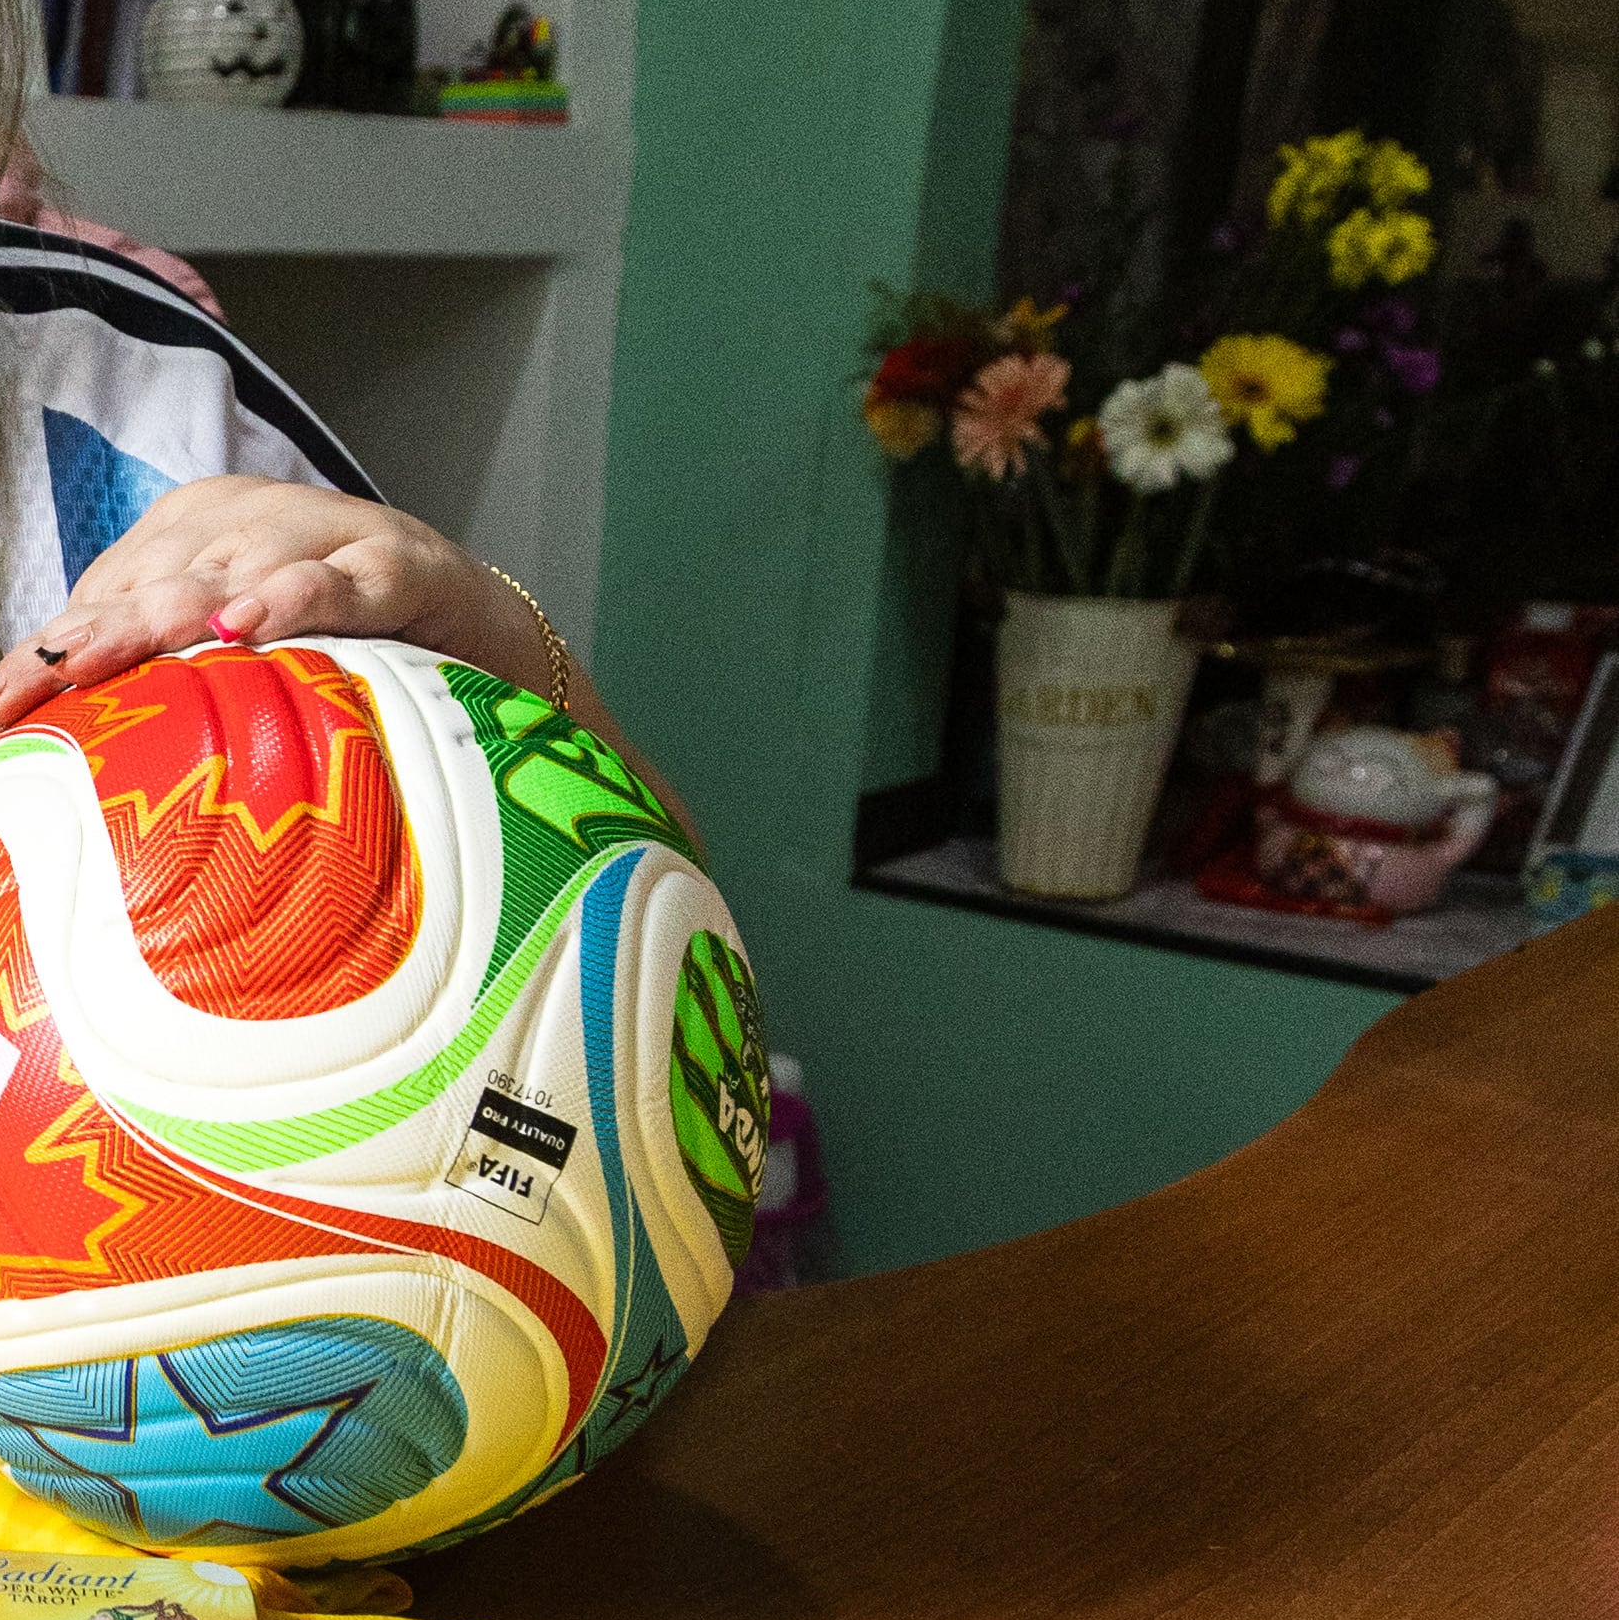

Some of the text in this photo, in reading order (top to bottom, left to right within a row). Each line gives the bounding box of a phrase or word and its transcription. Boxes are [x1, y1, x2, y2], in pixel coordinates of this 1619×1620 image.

[487, 1068, 554, 1109] 1017390
[482, 1106, 566, 1151] QUALITY PRO
[8, 1593, 80, 1606] TAROT
